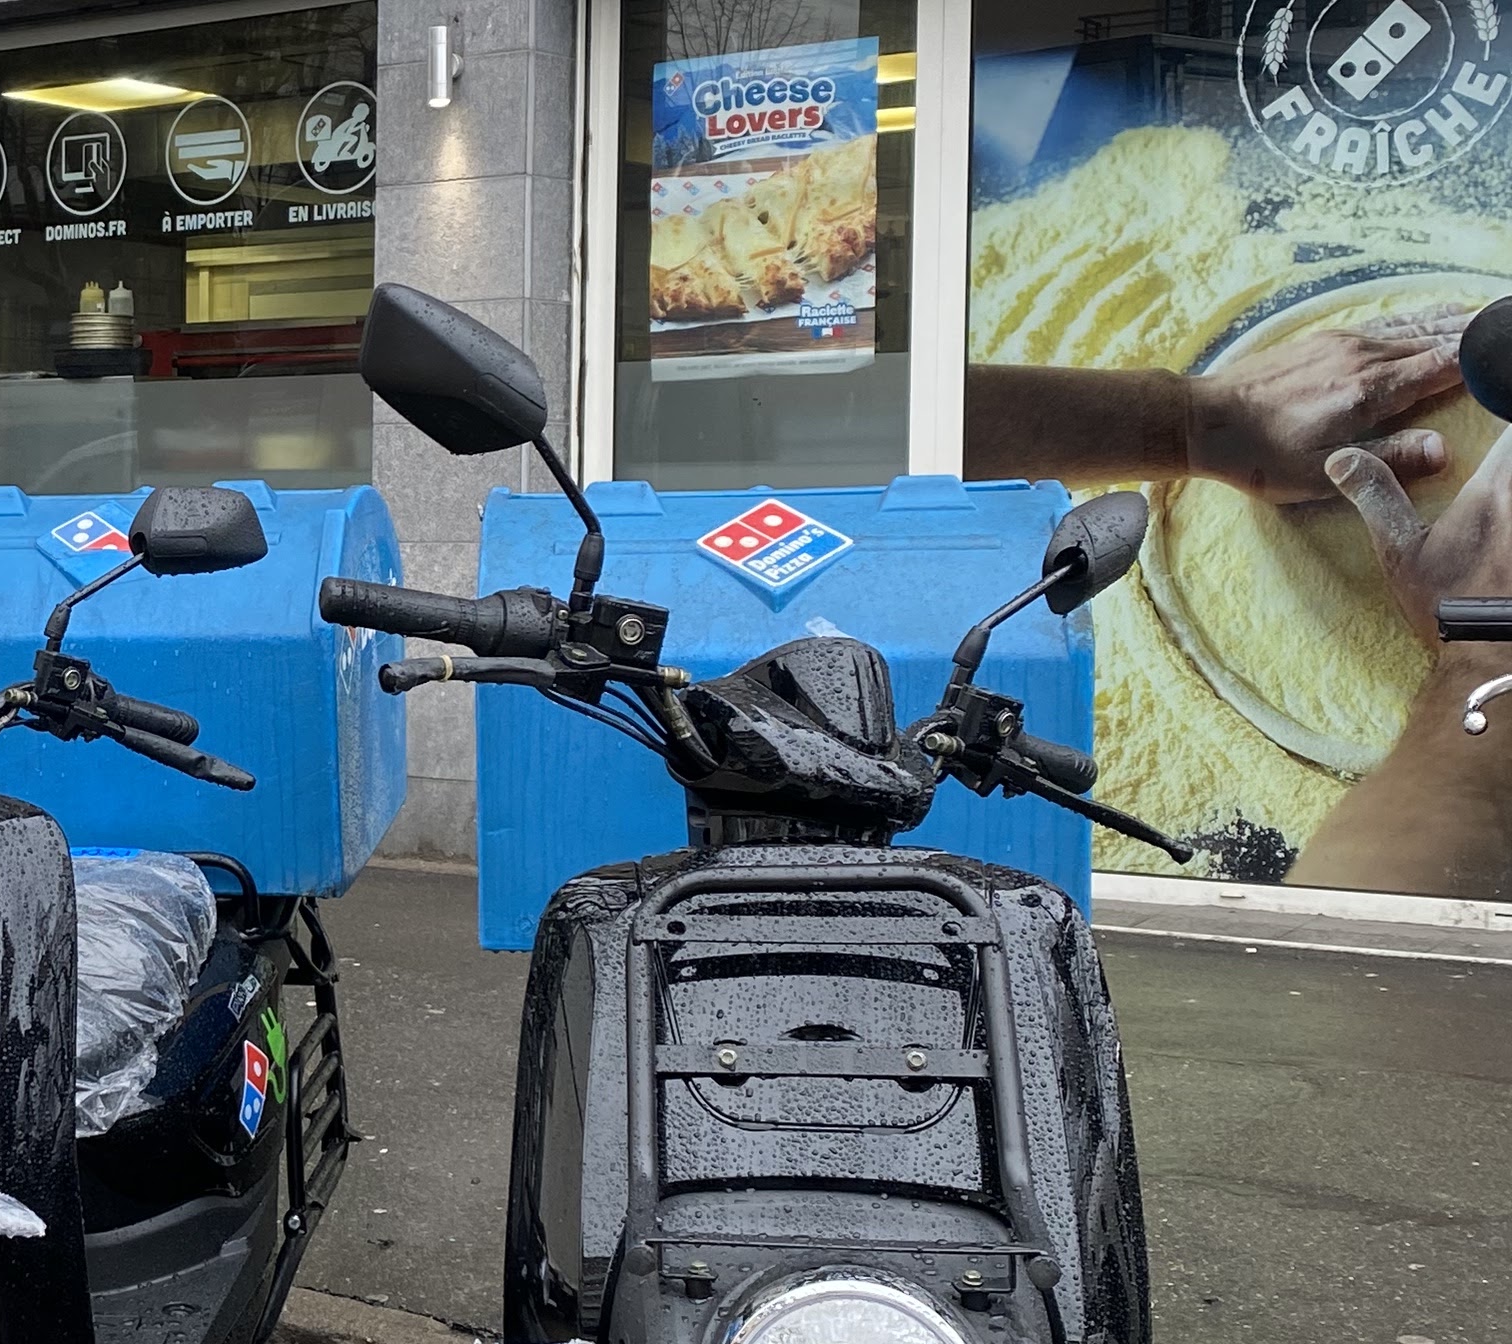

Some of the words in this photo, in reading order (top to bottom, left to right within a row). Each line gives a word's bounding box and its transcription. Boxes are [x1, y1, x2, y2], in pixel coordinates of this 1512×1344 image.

[694, 78, 834, 117] Cheese
[707, 105, 822, 137] Lovers
[1261, 61, 1507, 175] FRAÎCHE
[162, 211, 172, 233] À
[176, 210, 253, 231] EMPORTER
[289, 206, 309, 223] EN
[45, 220, 127, 242] DOMINOS.FR
[798, 315, 857, 327] FRANÇAISE
[801, 304, 854, 317] Raclette
[747, 527, 825, 572] Domino's
[763, 552, 814, 580] Pizza
